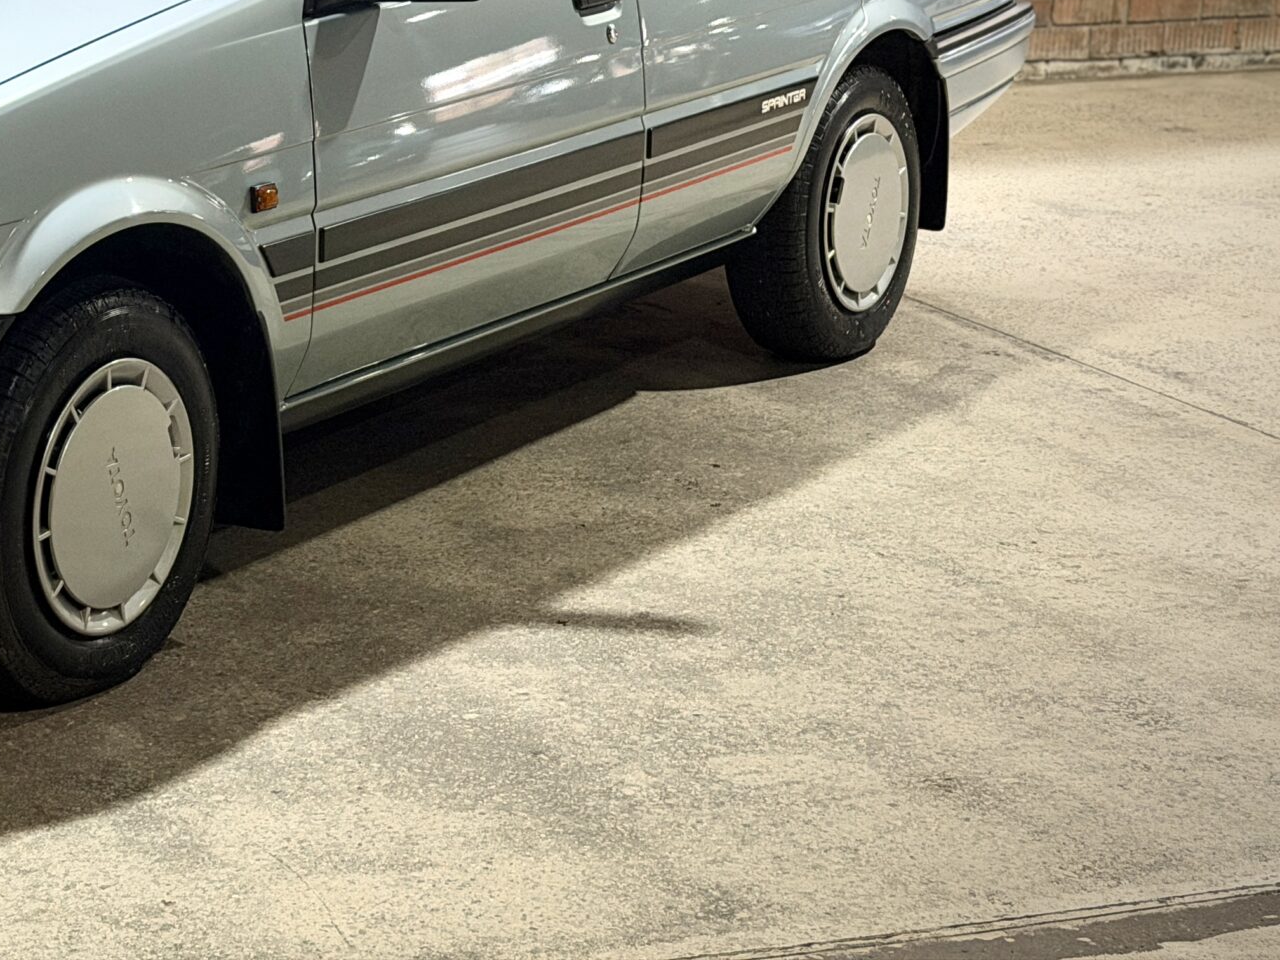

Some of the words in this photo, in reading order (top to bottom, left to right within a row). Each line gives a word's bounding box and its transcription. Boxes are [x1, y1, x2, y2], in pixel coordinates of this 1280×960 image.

[761, 88, 806, 114] SPRINTER
[860, 176, 881, 249] TOYOTA
[106, 446, 136, 547] TOYOTA
